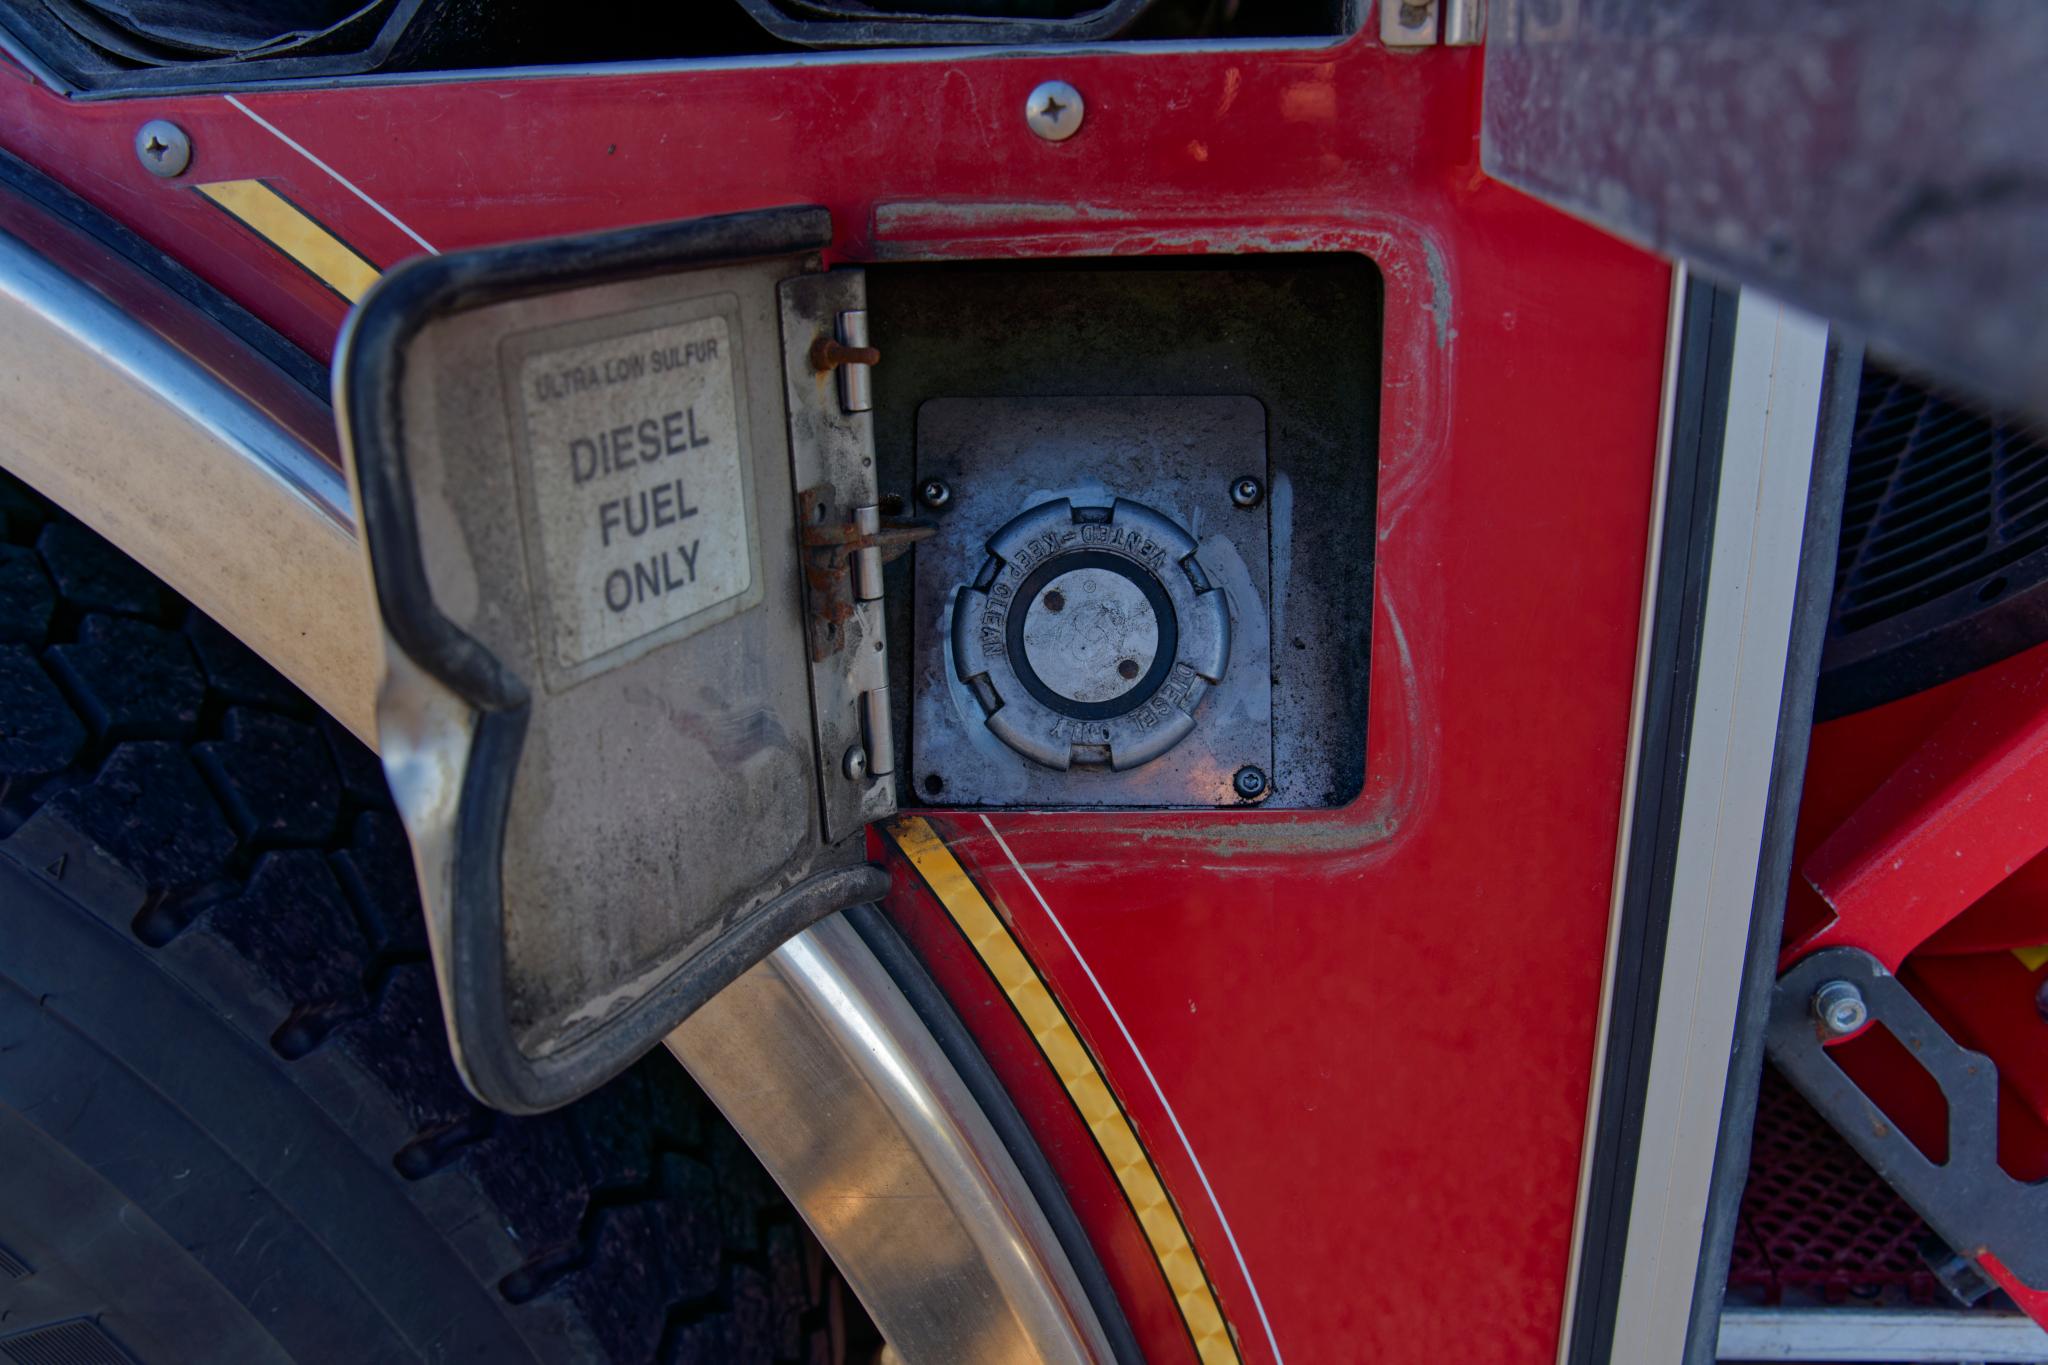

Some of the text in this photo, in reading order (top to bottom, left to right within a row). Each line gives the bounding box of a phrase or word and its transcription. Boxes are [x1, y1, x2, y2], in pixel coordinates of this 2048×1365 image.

[536, 340, 720, 402] ULTRA LOW SULFUR
[570, 407, 710, 485] DIESEL
[598, 479, 699, 547] FUEL
[604, 540, 702, 613] ONLY
[981, 582, 1013, 657] CLEAN
[1131, 662, 1196, 733] DIESEL
